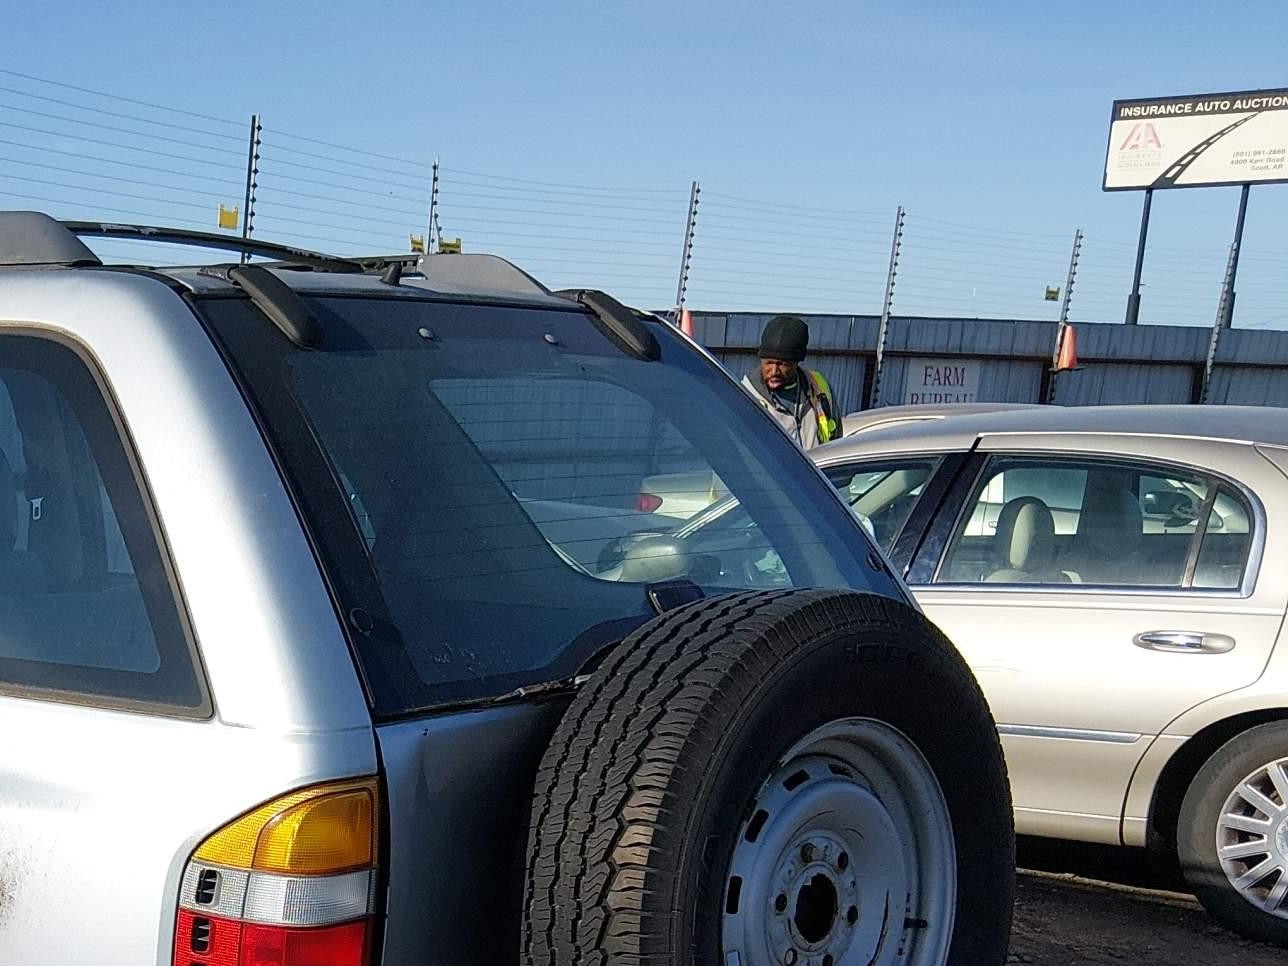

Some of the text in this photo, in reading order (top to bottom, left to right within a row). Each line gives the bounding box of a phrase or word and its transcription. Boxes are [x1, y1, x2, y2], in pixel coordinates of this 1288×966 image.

[1120, 103, 1192, 117] INSURANCE
[1195, 99, 1230, 112] AUTO
[923, 366, 966, 387] FARM
